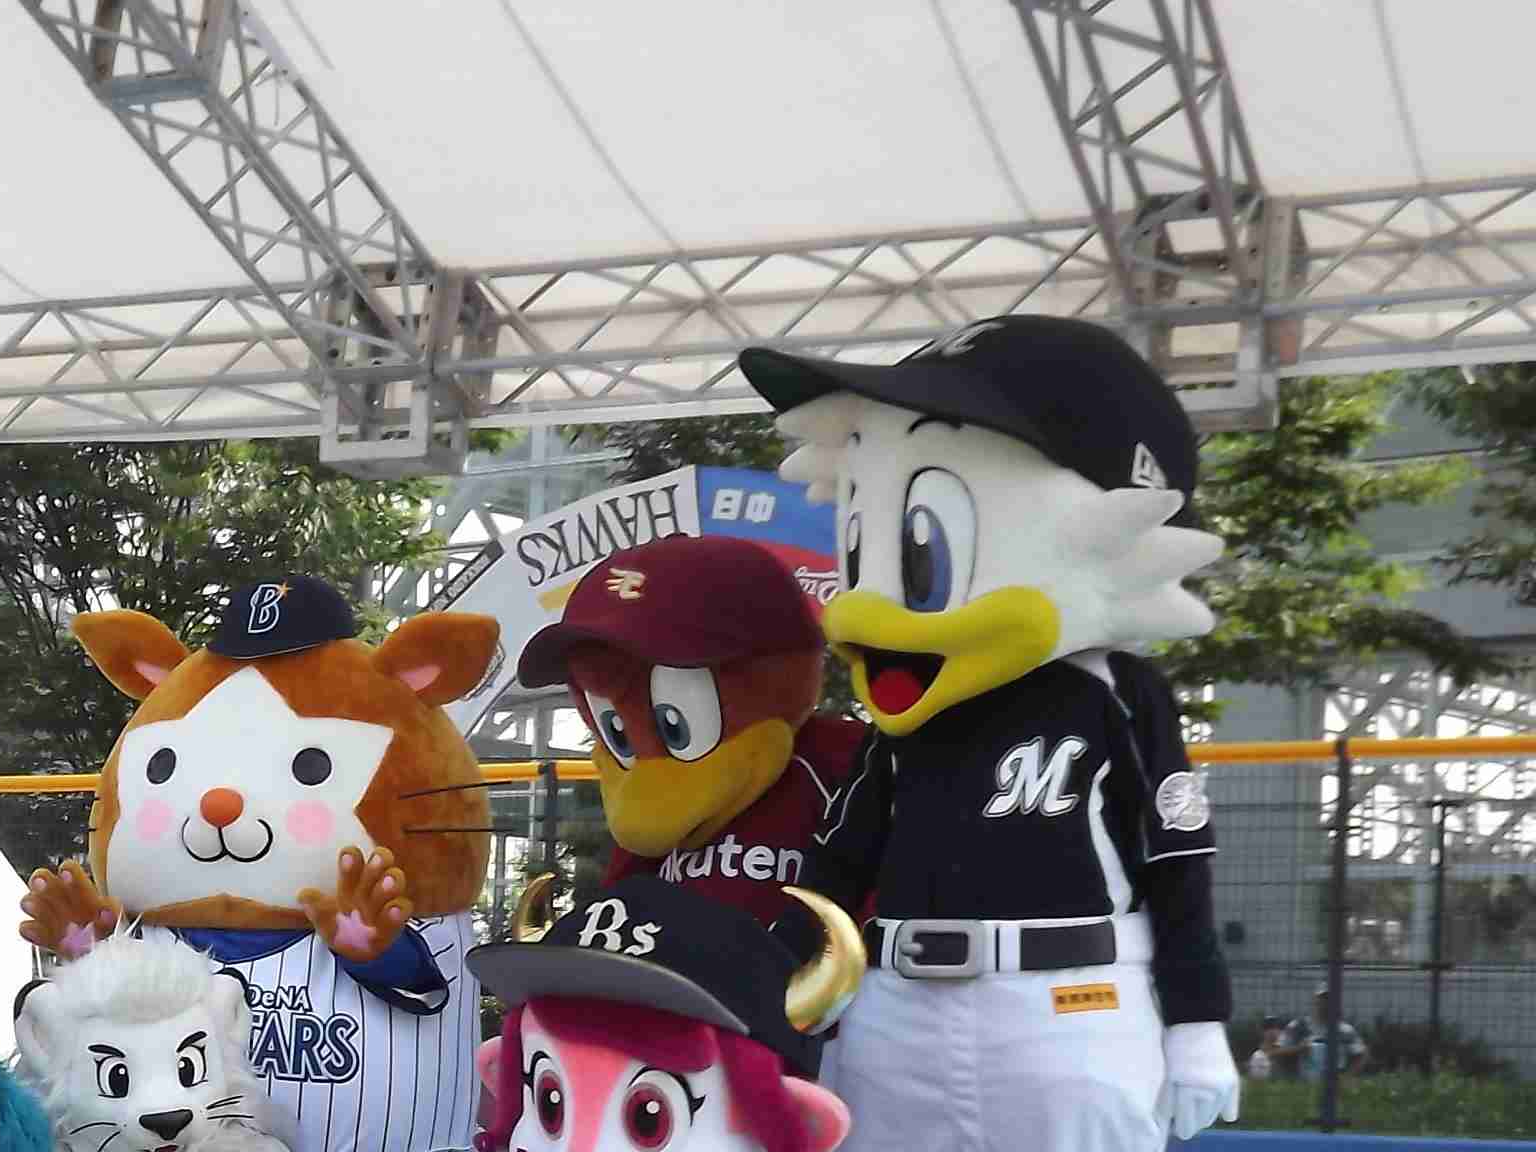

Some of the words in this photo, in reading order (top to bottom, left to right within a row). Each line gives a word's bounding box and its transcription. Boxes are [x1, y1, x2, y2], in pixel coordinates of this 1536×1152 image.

[516, 483, 682, 588] HAWKS
[247, 583, 285, 634] B
[982, 735, 1089, 819] M
[658, 833, 804, 884] kuten
